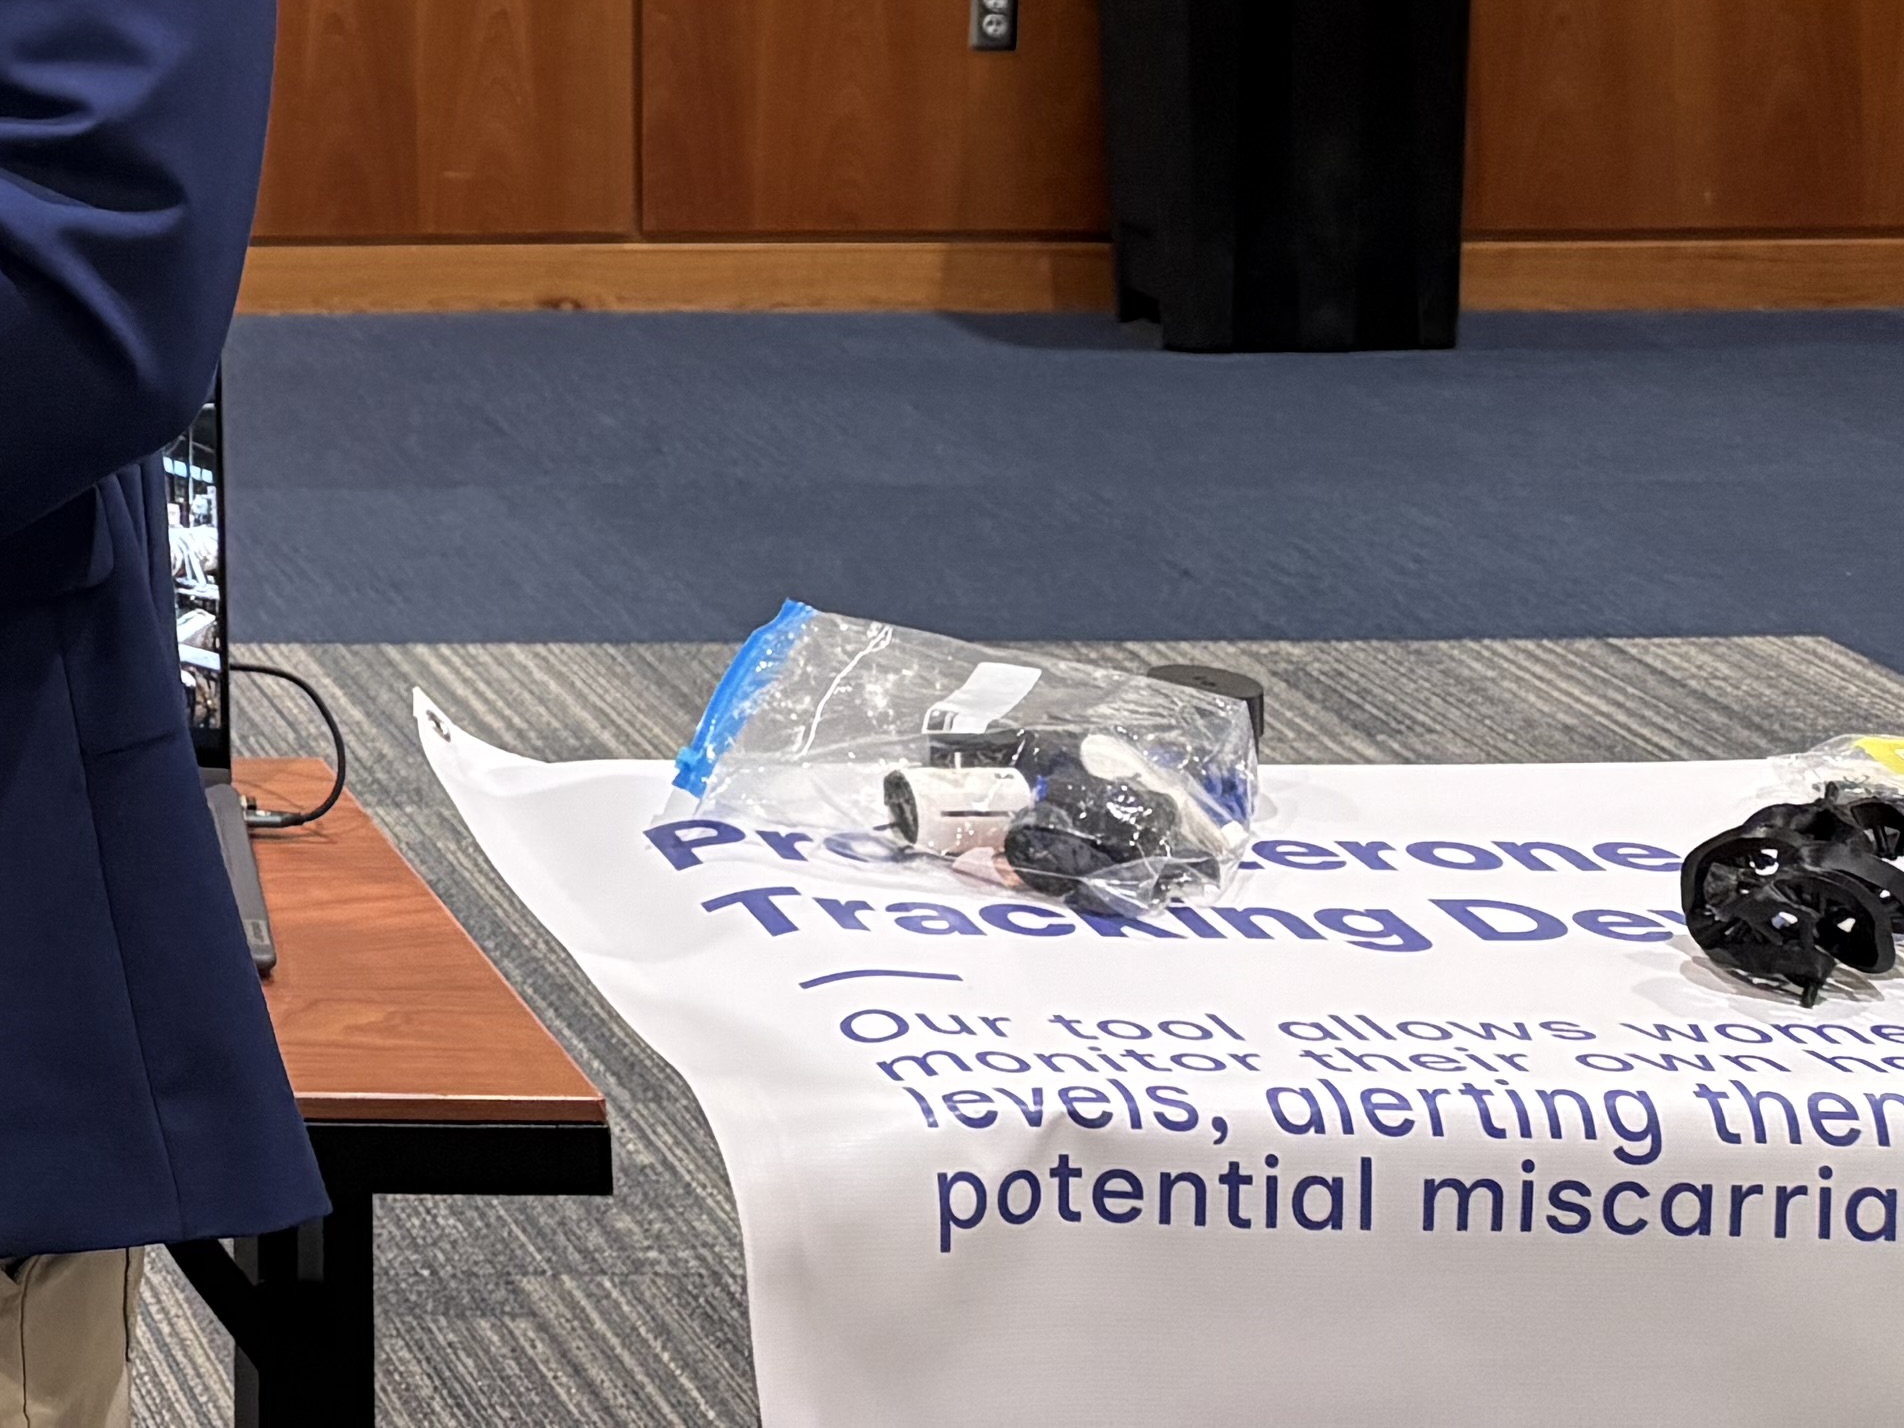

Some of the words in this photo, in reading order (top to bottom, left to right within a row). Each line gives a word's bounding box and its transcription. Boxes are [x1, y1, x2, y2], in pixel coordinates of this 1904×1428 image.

[839, 1010, 1012, 1043] Our
[1049, 1014, 1247, 1041] tool
[1278, 1015, 1597, 1041] allows
[877, 1048, 1261, 1080] monitor
[1301, 1048, 1529, 1072] their
[1577, 1052, 1792, 1073] own
[905, 1080, 1229, 1144] levels,
[1265, 1080, 1662, 1166] alerting
[938, 1154, 1372, 1253] potential
